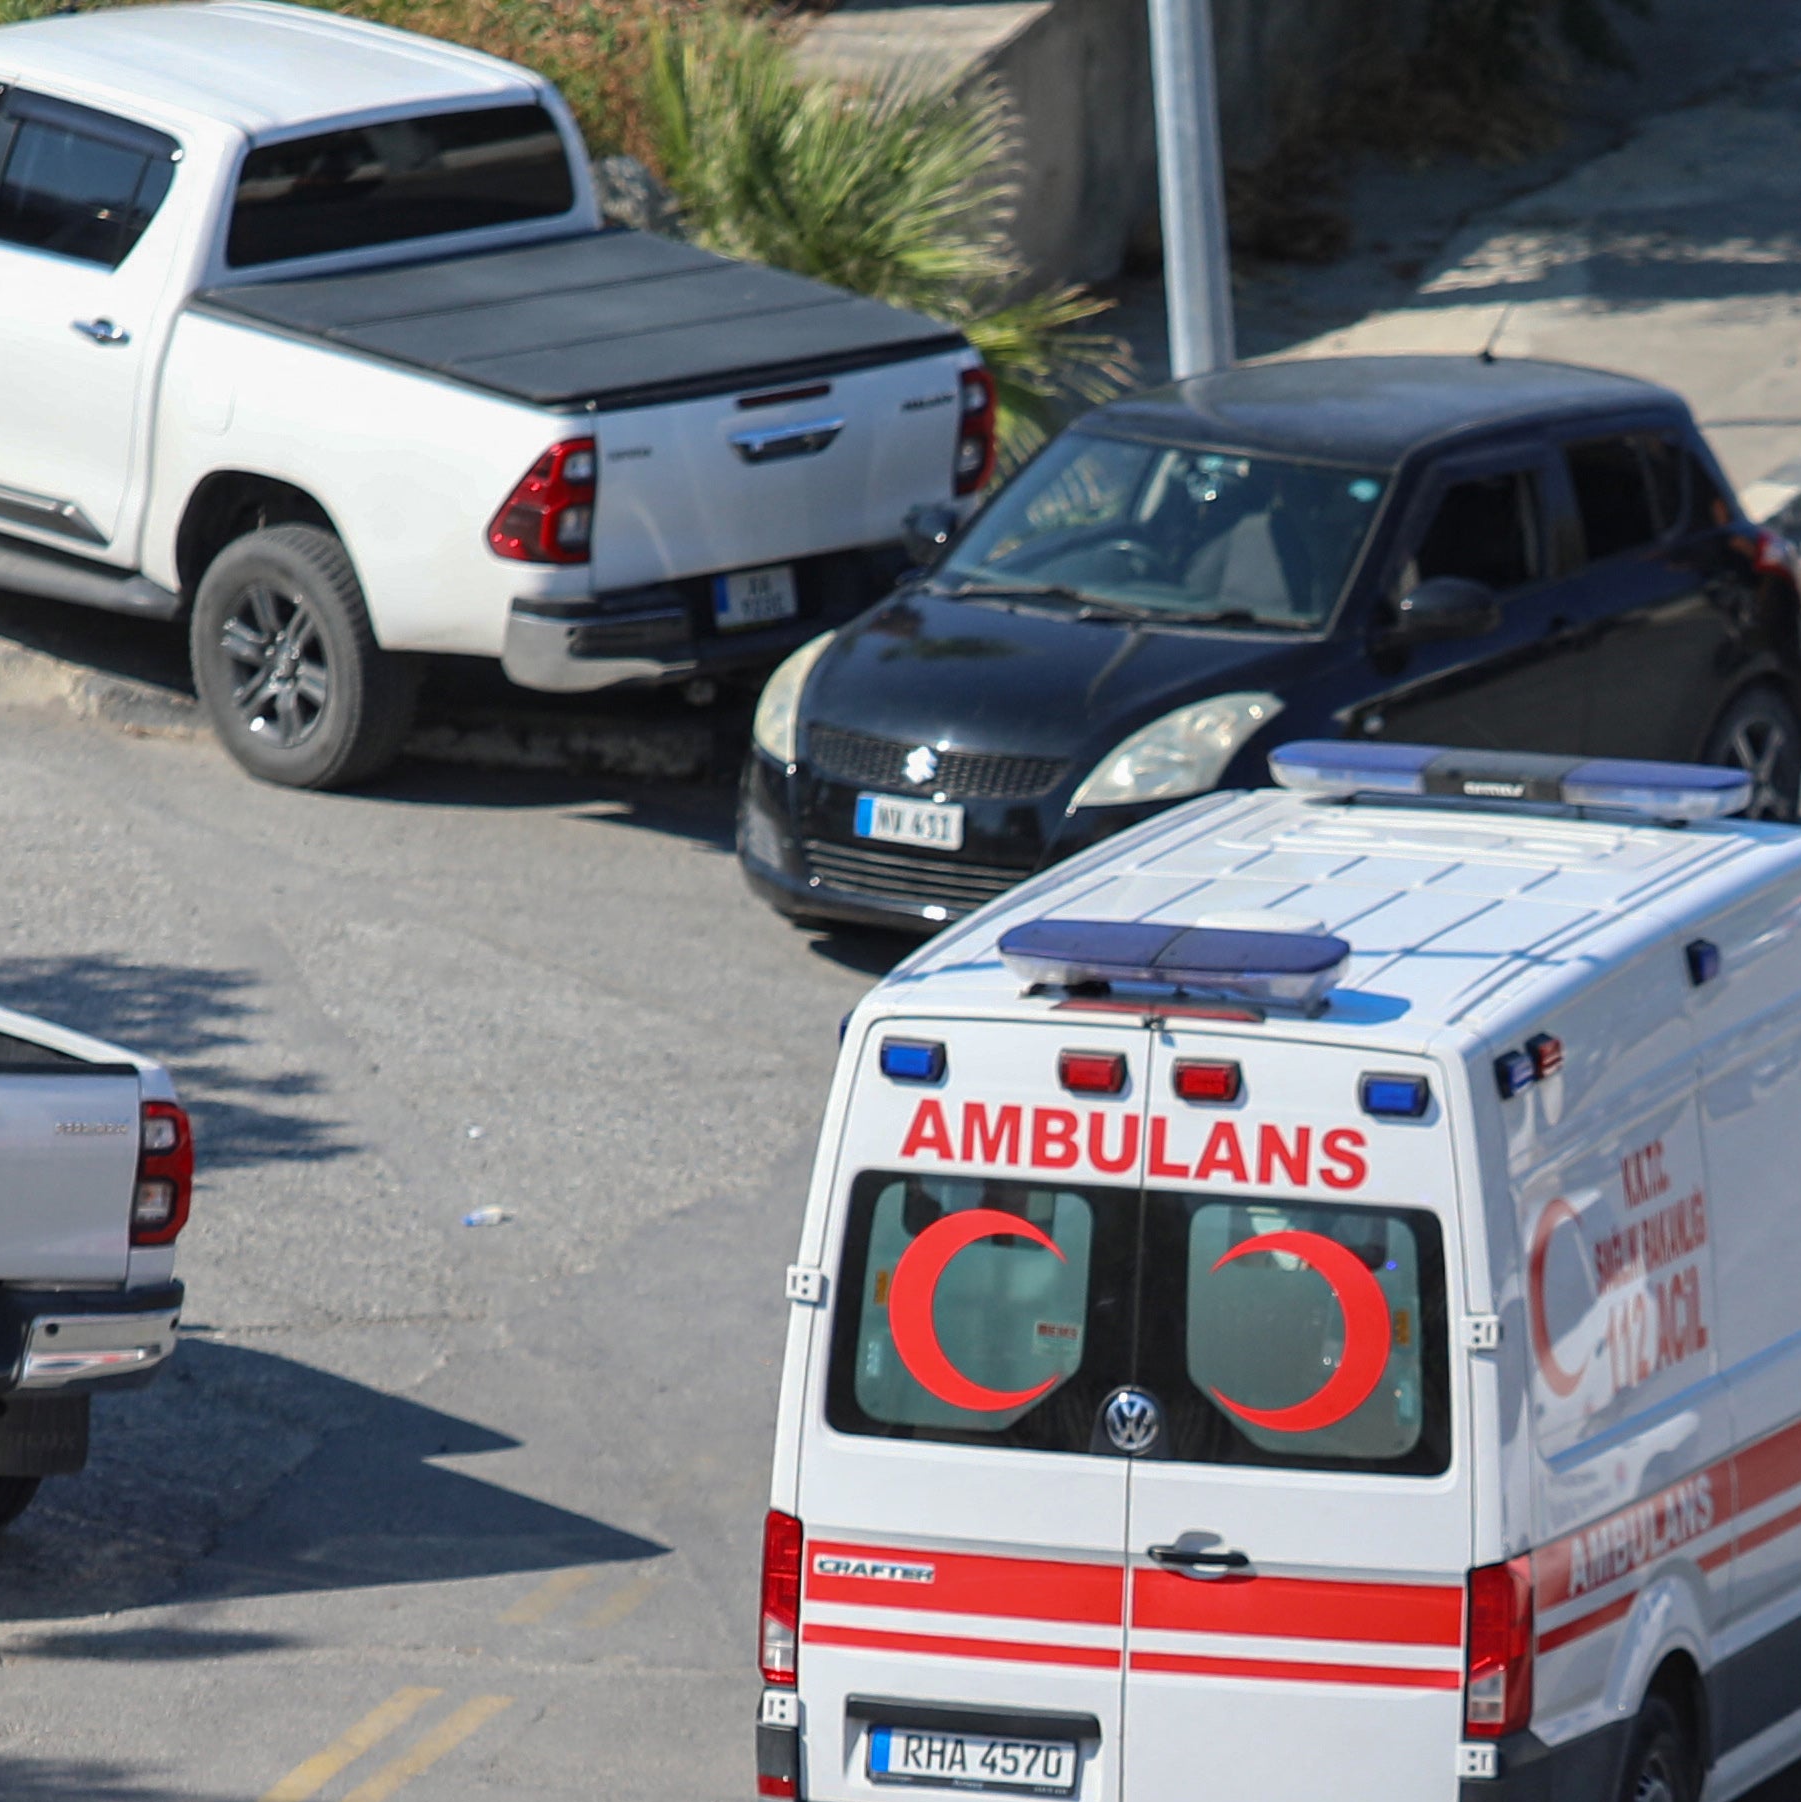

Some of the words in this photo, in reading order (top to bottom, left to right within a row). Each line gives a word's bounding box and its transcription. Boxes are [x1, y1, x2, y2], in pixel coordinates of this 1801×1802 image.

[900, 1099, 1368, 1189] AMBULANS
[1608, 1293, 1650, 1393] 112
[818, 1558, 933, 1580] CRAFTER
[1567, 1475, 1713, 1598] AMBULANS
[903, 1735, 967, 1772] RHA
[980, 1742, 1061, 1778] 4570
